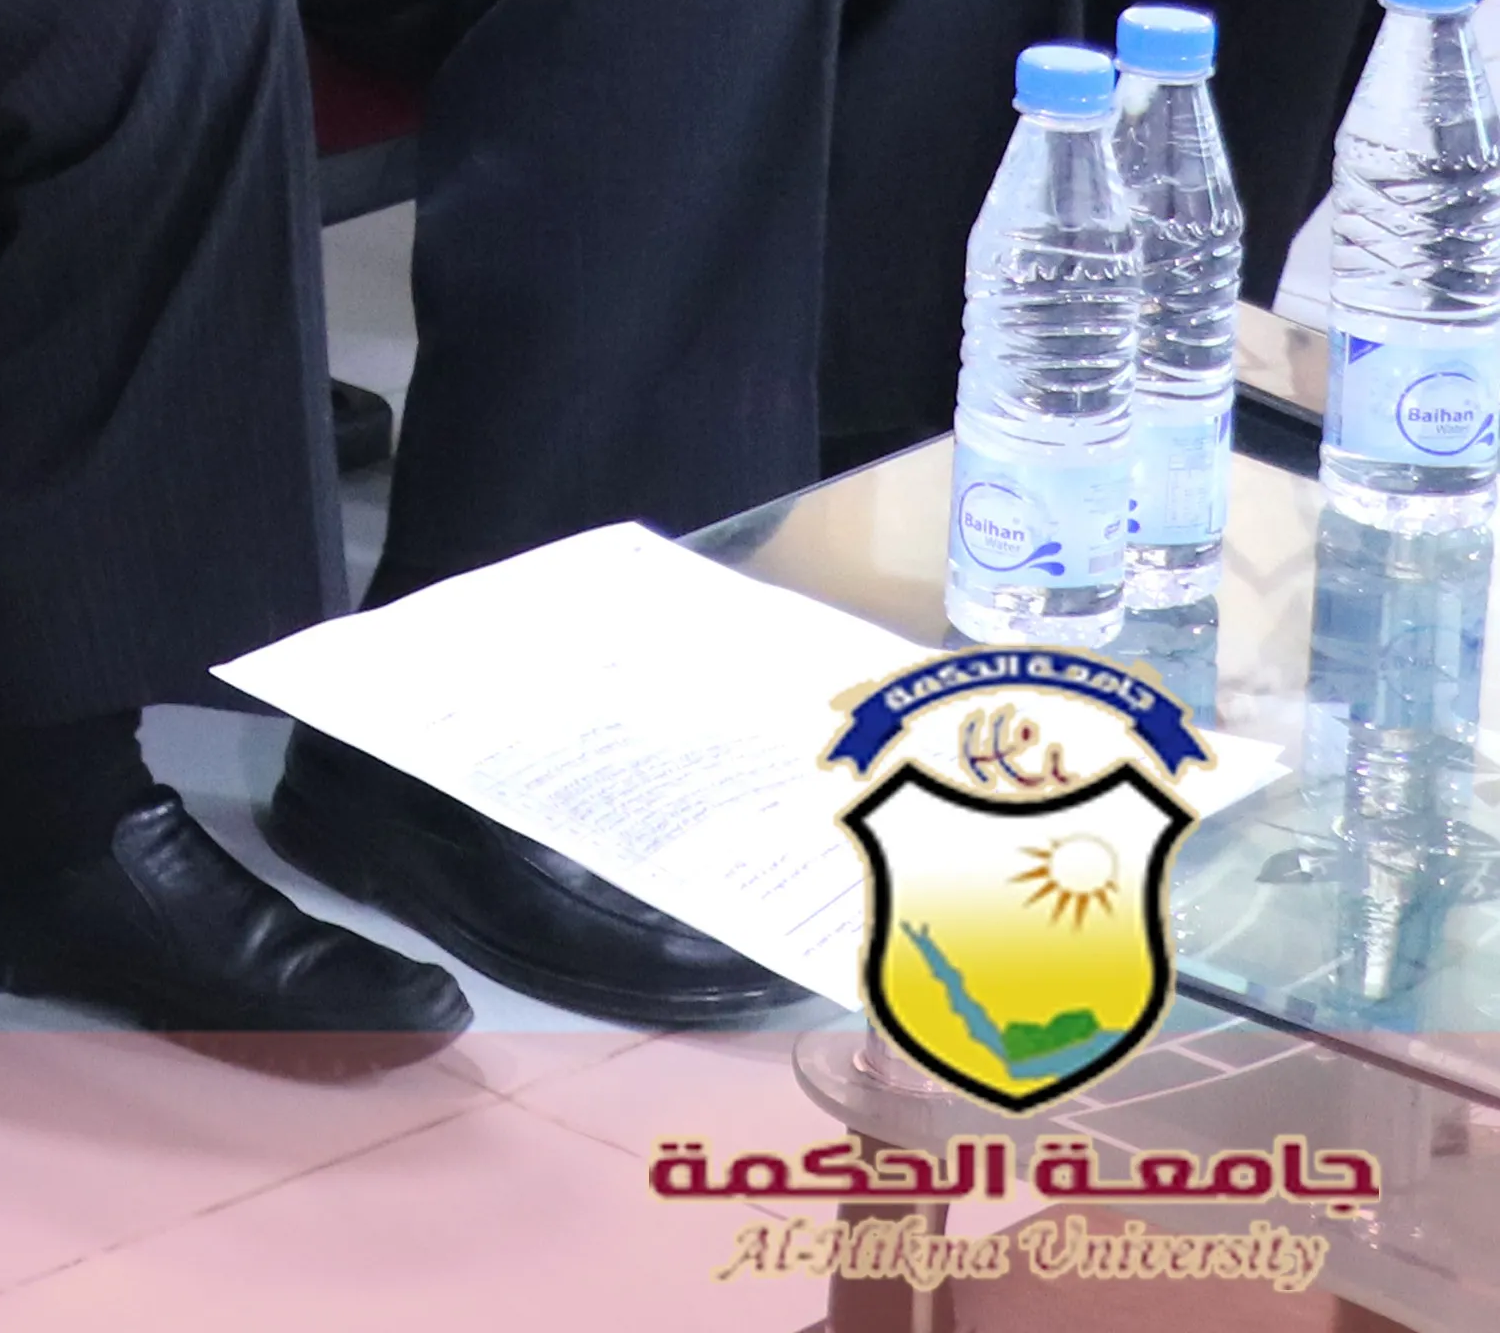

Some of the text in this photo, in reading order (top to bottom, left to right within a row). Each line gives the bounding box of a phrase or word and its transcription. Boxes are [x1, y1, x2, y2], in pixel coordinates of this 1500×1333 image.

[1407, 408, 1474, 423] Baihan
[964, 512, 1025, 542] Baihan
[985, 536, 1021, 553] Water
